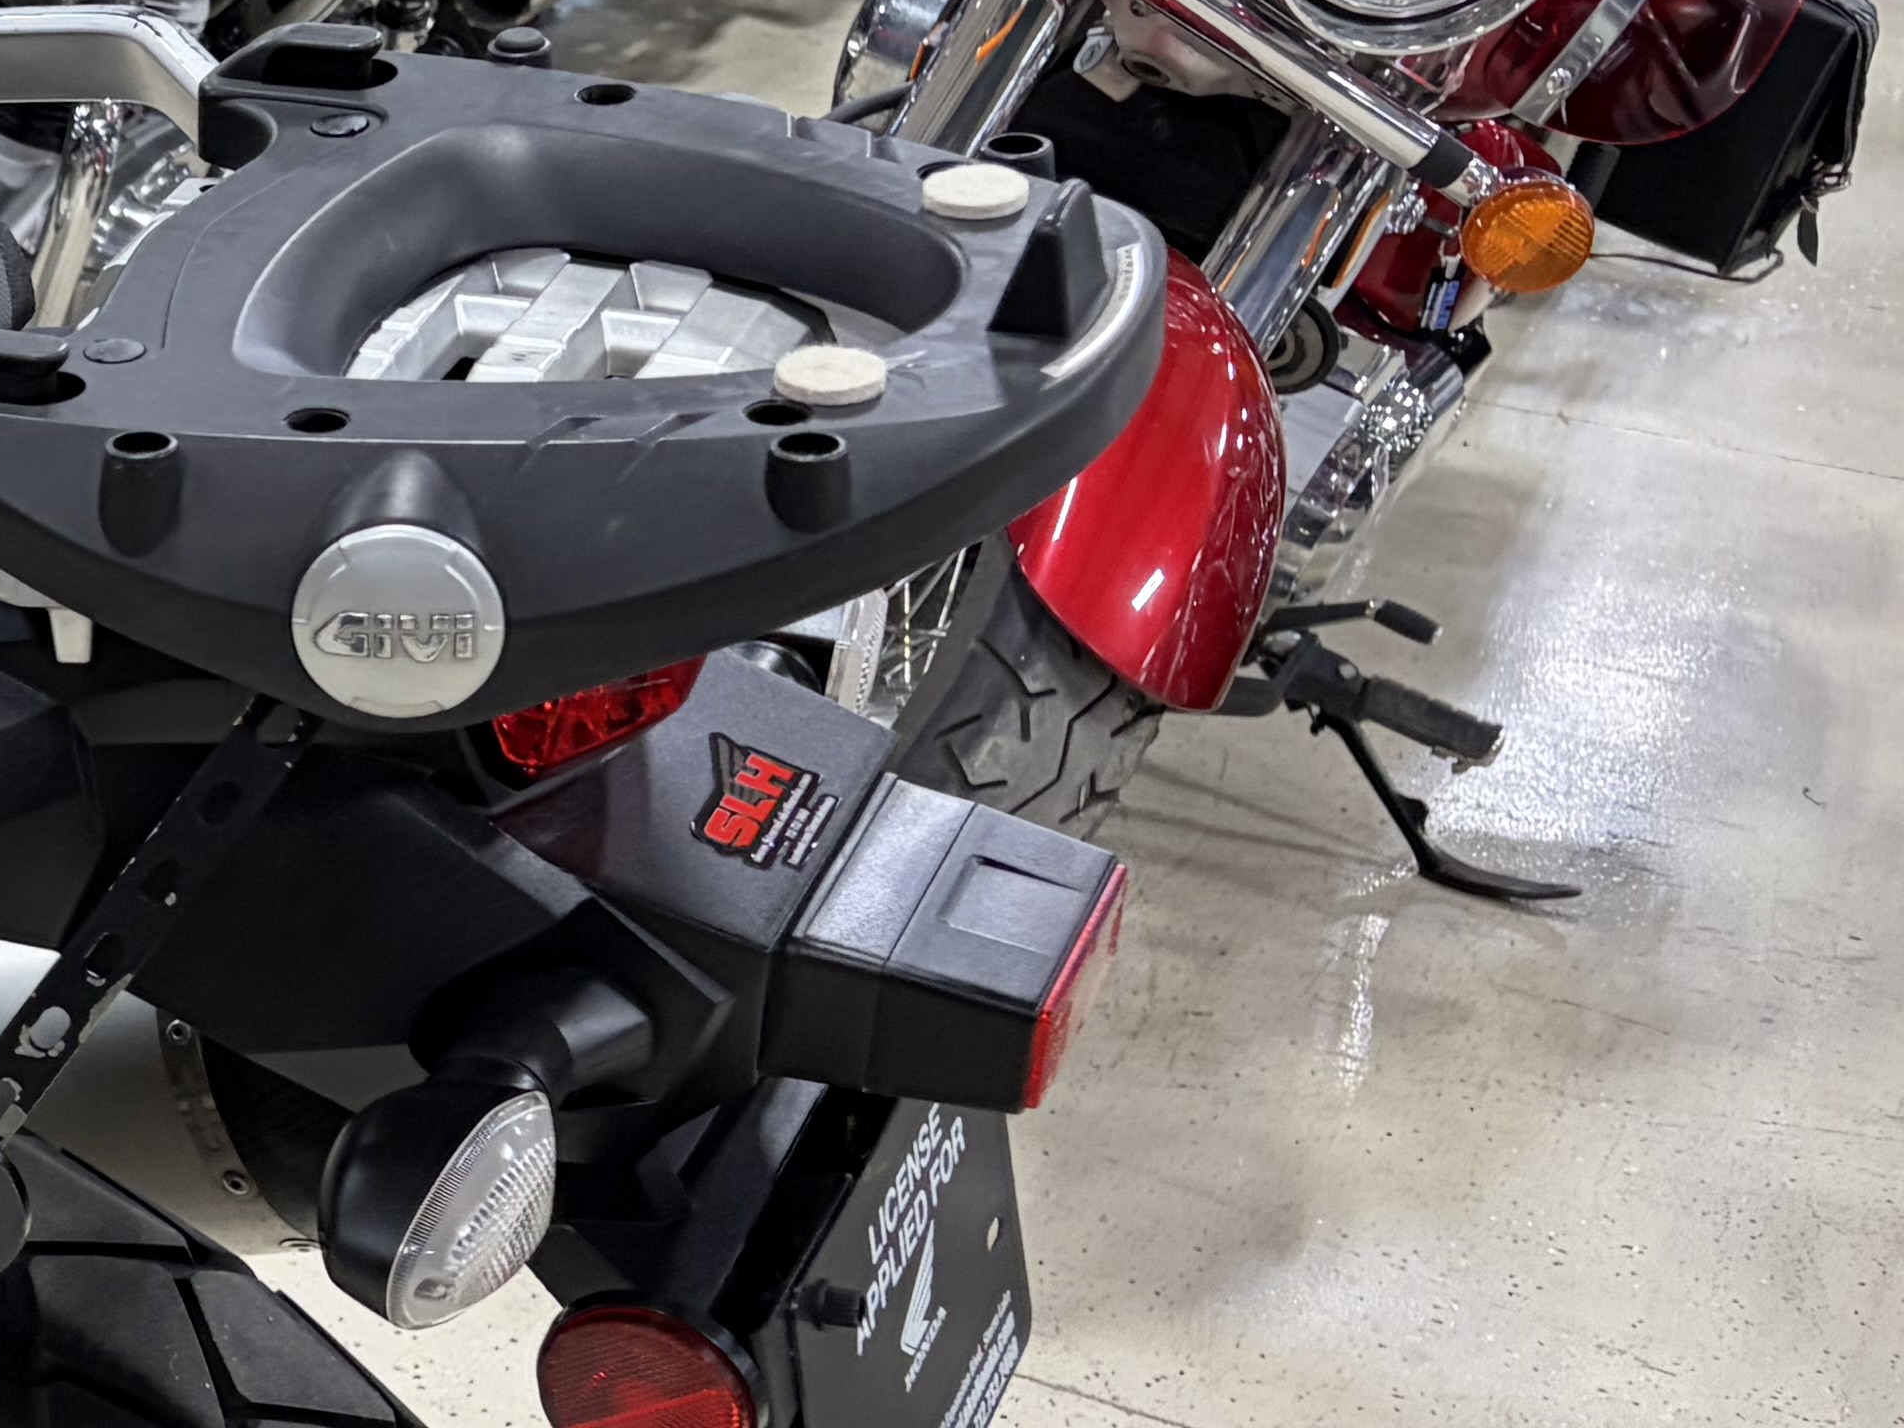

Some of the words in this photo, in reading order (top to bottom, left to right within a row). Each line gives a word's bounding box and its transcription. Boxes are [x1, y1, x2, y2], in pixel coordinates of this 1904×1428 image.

[704, 753, 795, 848] SLH
[857, 1189, 928, 1356] APPLIED
[930, 1116, 966, 1207] FOR
[869, 1102, 943, 1265] LICENSE
[904, 1306, 947, 1393] HONDA
